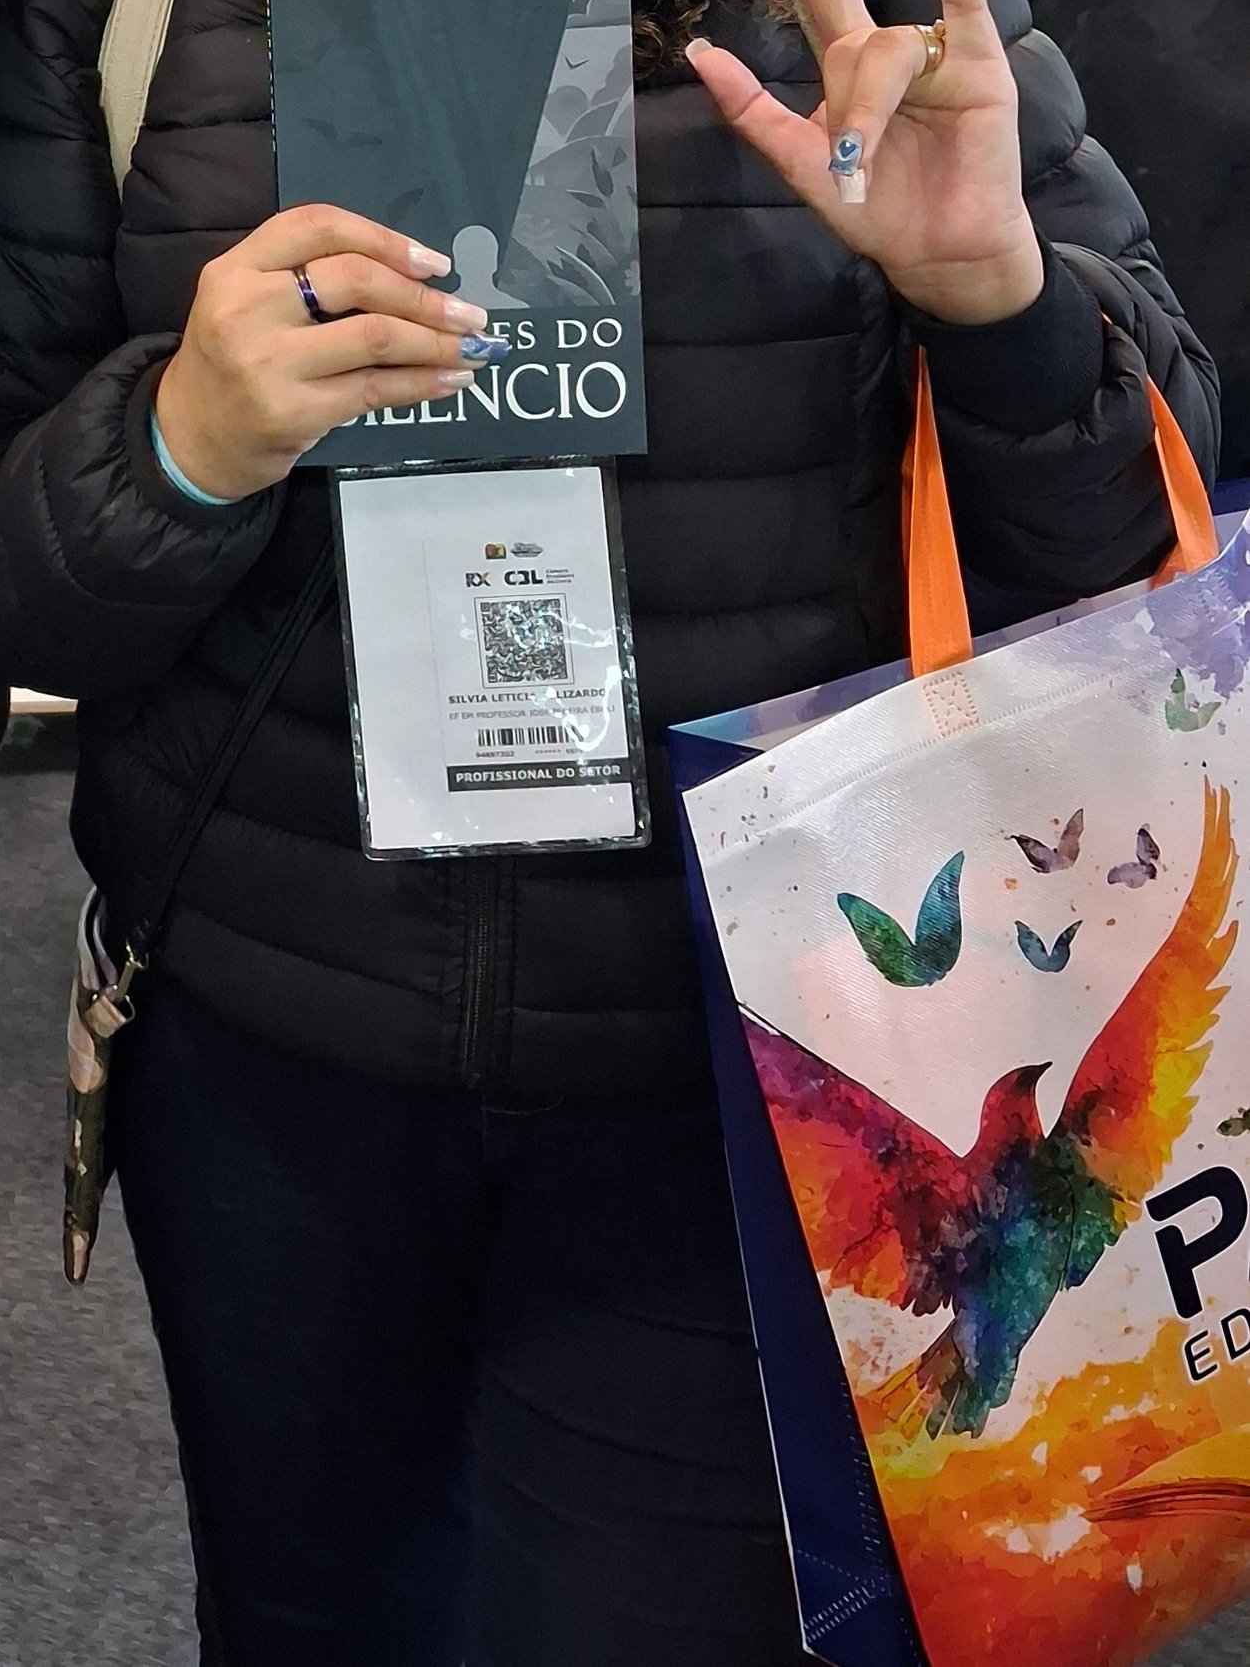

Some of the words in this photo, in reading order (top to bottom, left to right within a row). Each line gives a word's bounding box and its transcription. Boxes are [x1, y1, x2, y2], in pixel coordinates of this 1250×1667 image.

[557, 317, 623, 350] DO
[448, 695, 488, 704] SILVIA
[455, 768, 553, 783] PROFISSIONAL
[556, 767, 575, 778] DO
[578, 764, 622, 777] SETOR
